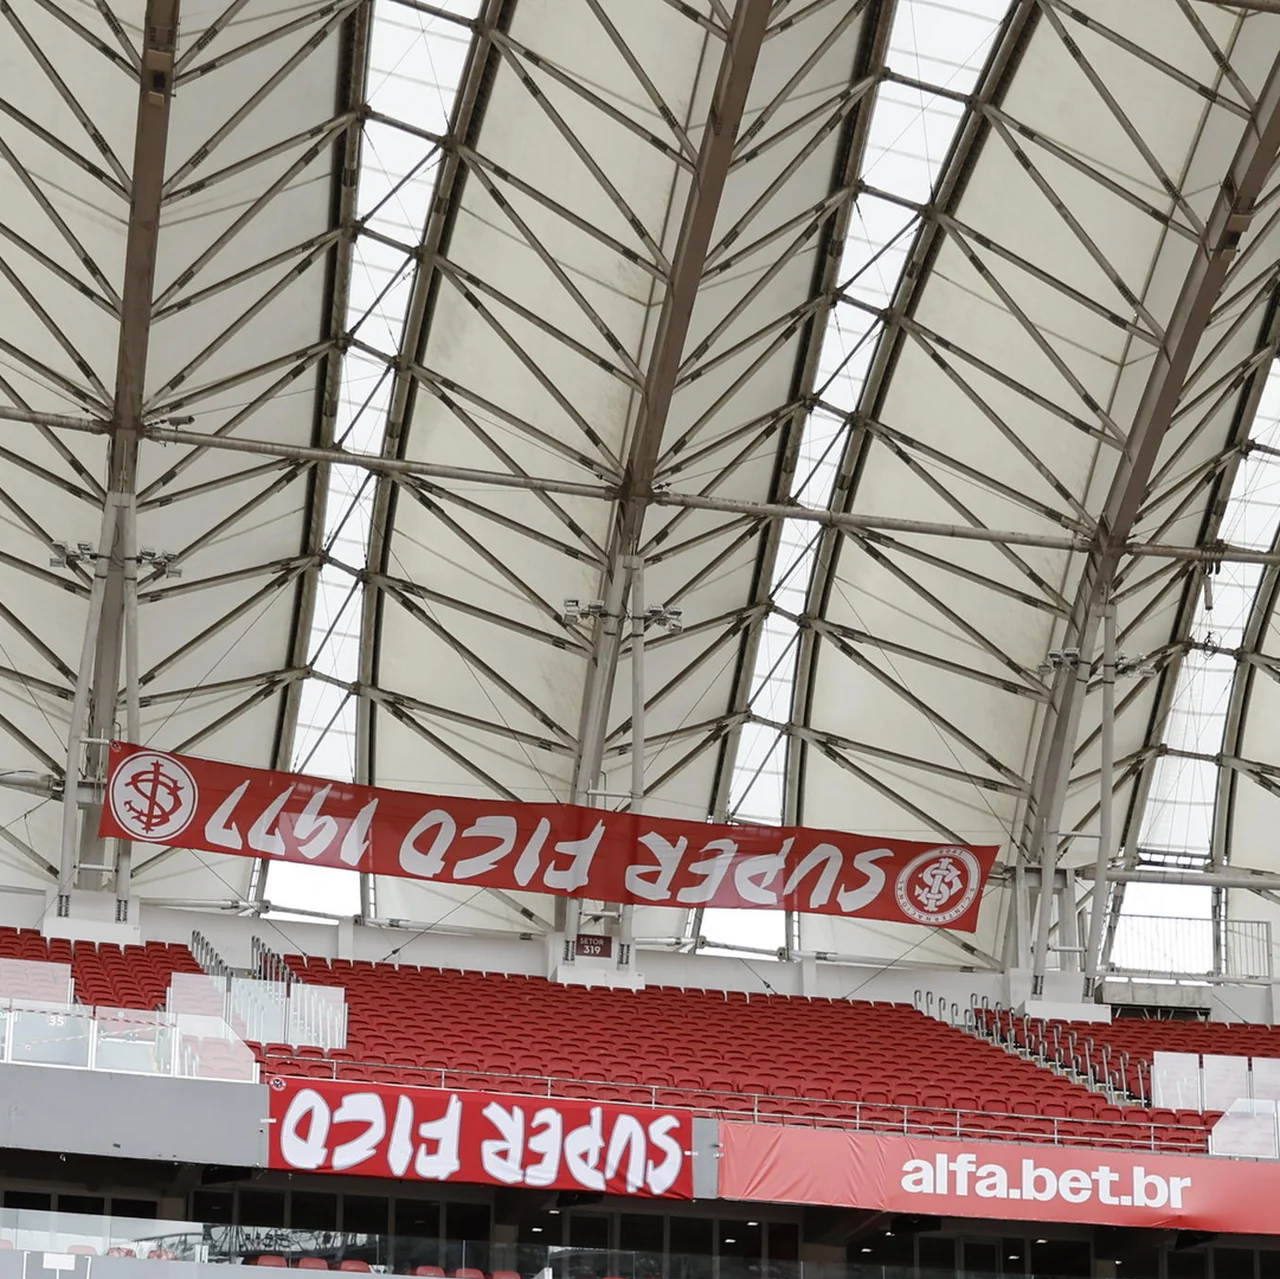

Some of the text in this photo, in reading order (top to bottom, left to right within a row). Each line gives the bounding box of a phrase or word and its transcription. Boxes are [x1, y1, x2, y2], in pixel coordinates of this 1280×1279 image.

[205, 779, 895, 912] SUPER FICO 1977
[579, 937, 605, 946] SETOR
[583, 945, 601, 954] 319
[49, 1015, 65, 1027] 35
[280, 1088, 682, 1195] SUPER FICO
[901, 1153, 1192, 1209] alfa.bet.br
